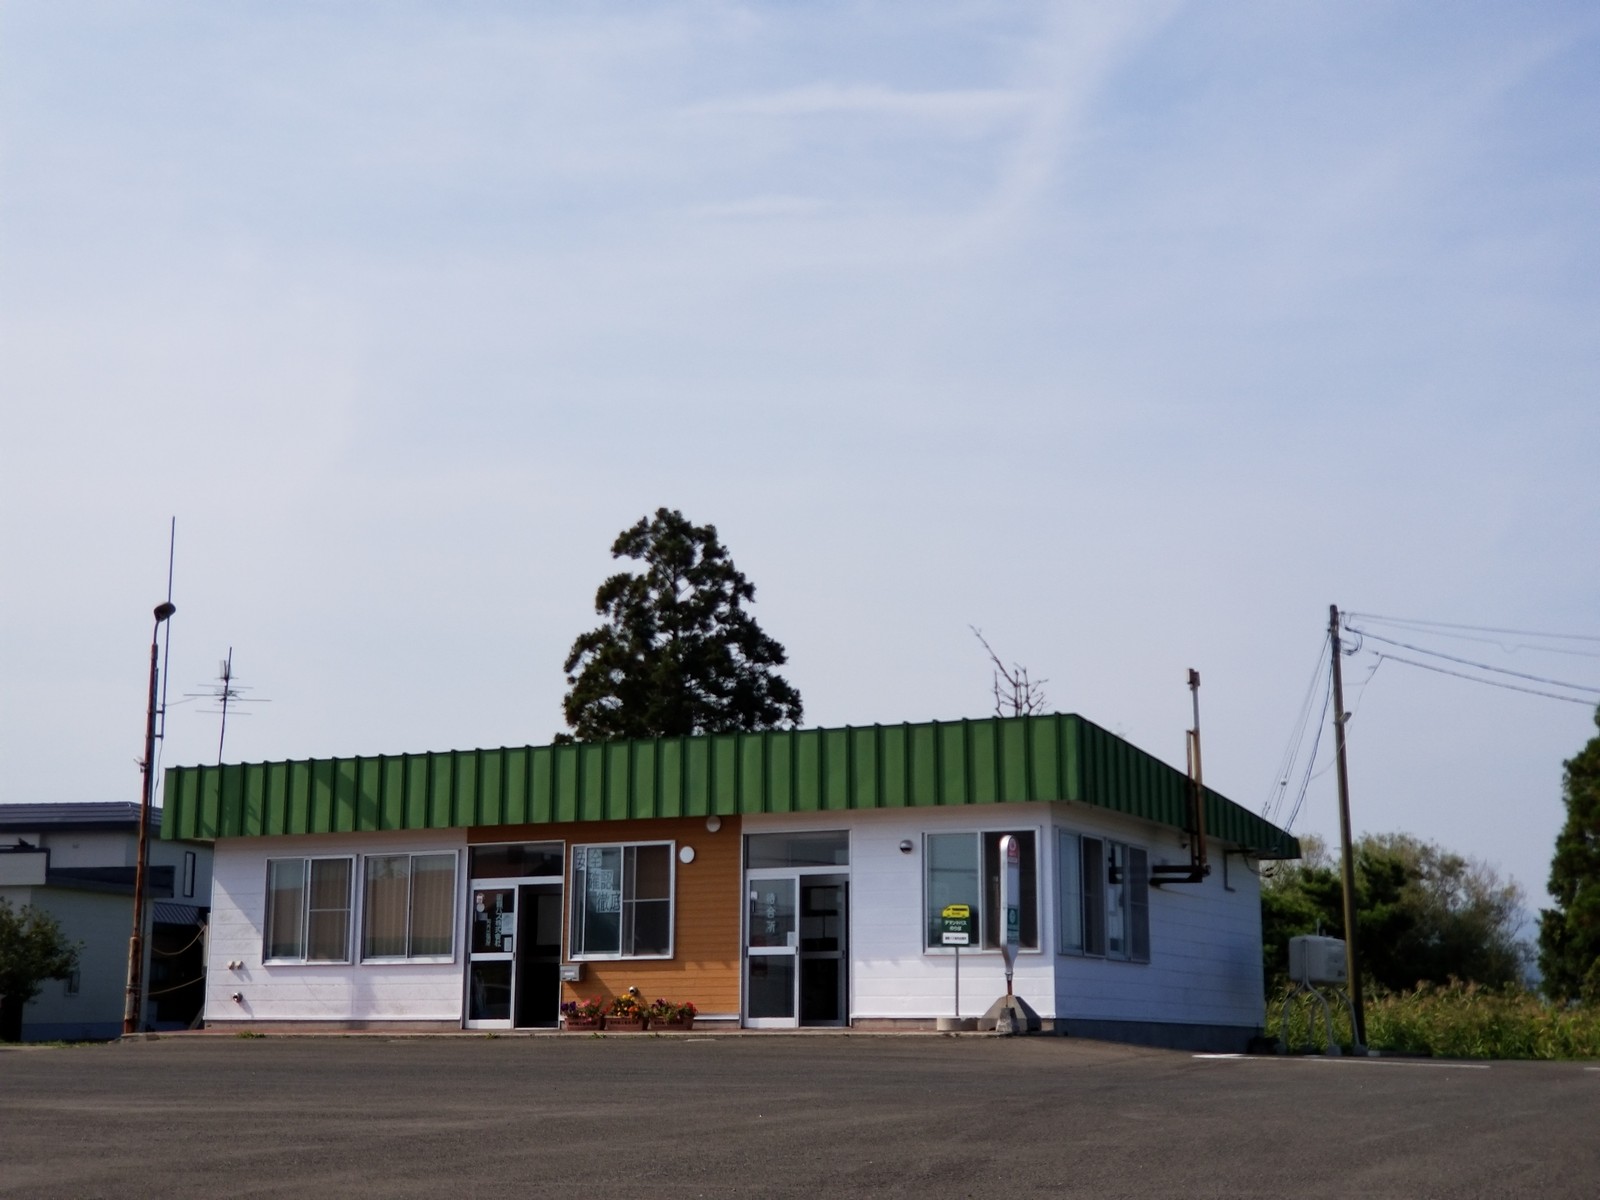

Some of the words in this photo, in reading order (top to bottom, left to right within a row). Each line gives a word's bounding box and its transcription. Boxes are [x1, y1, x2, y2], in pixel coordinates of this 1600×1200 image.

[576, 849, 602, 870] 安全
[588, 870, 613, 891] 確認
[766, 893, 776, 933] 待合所
